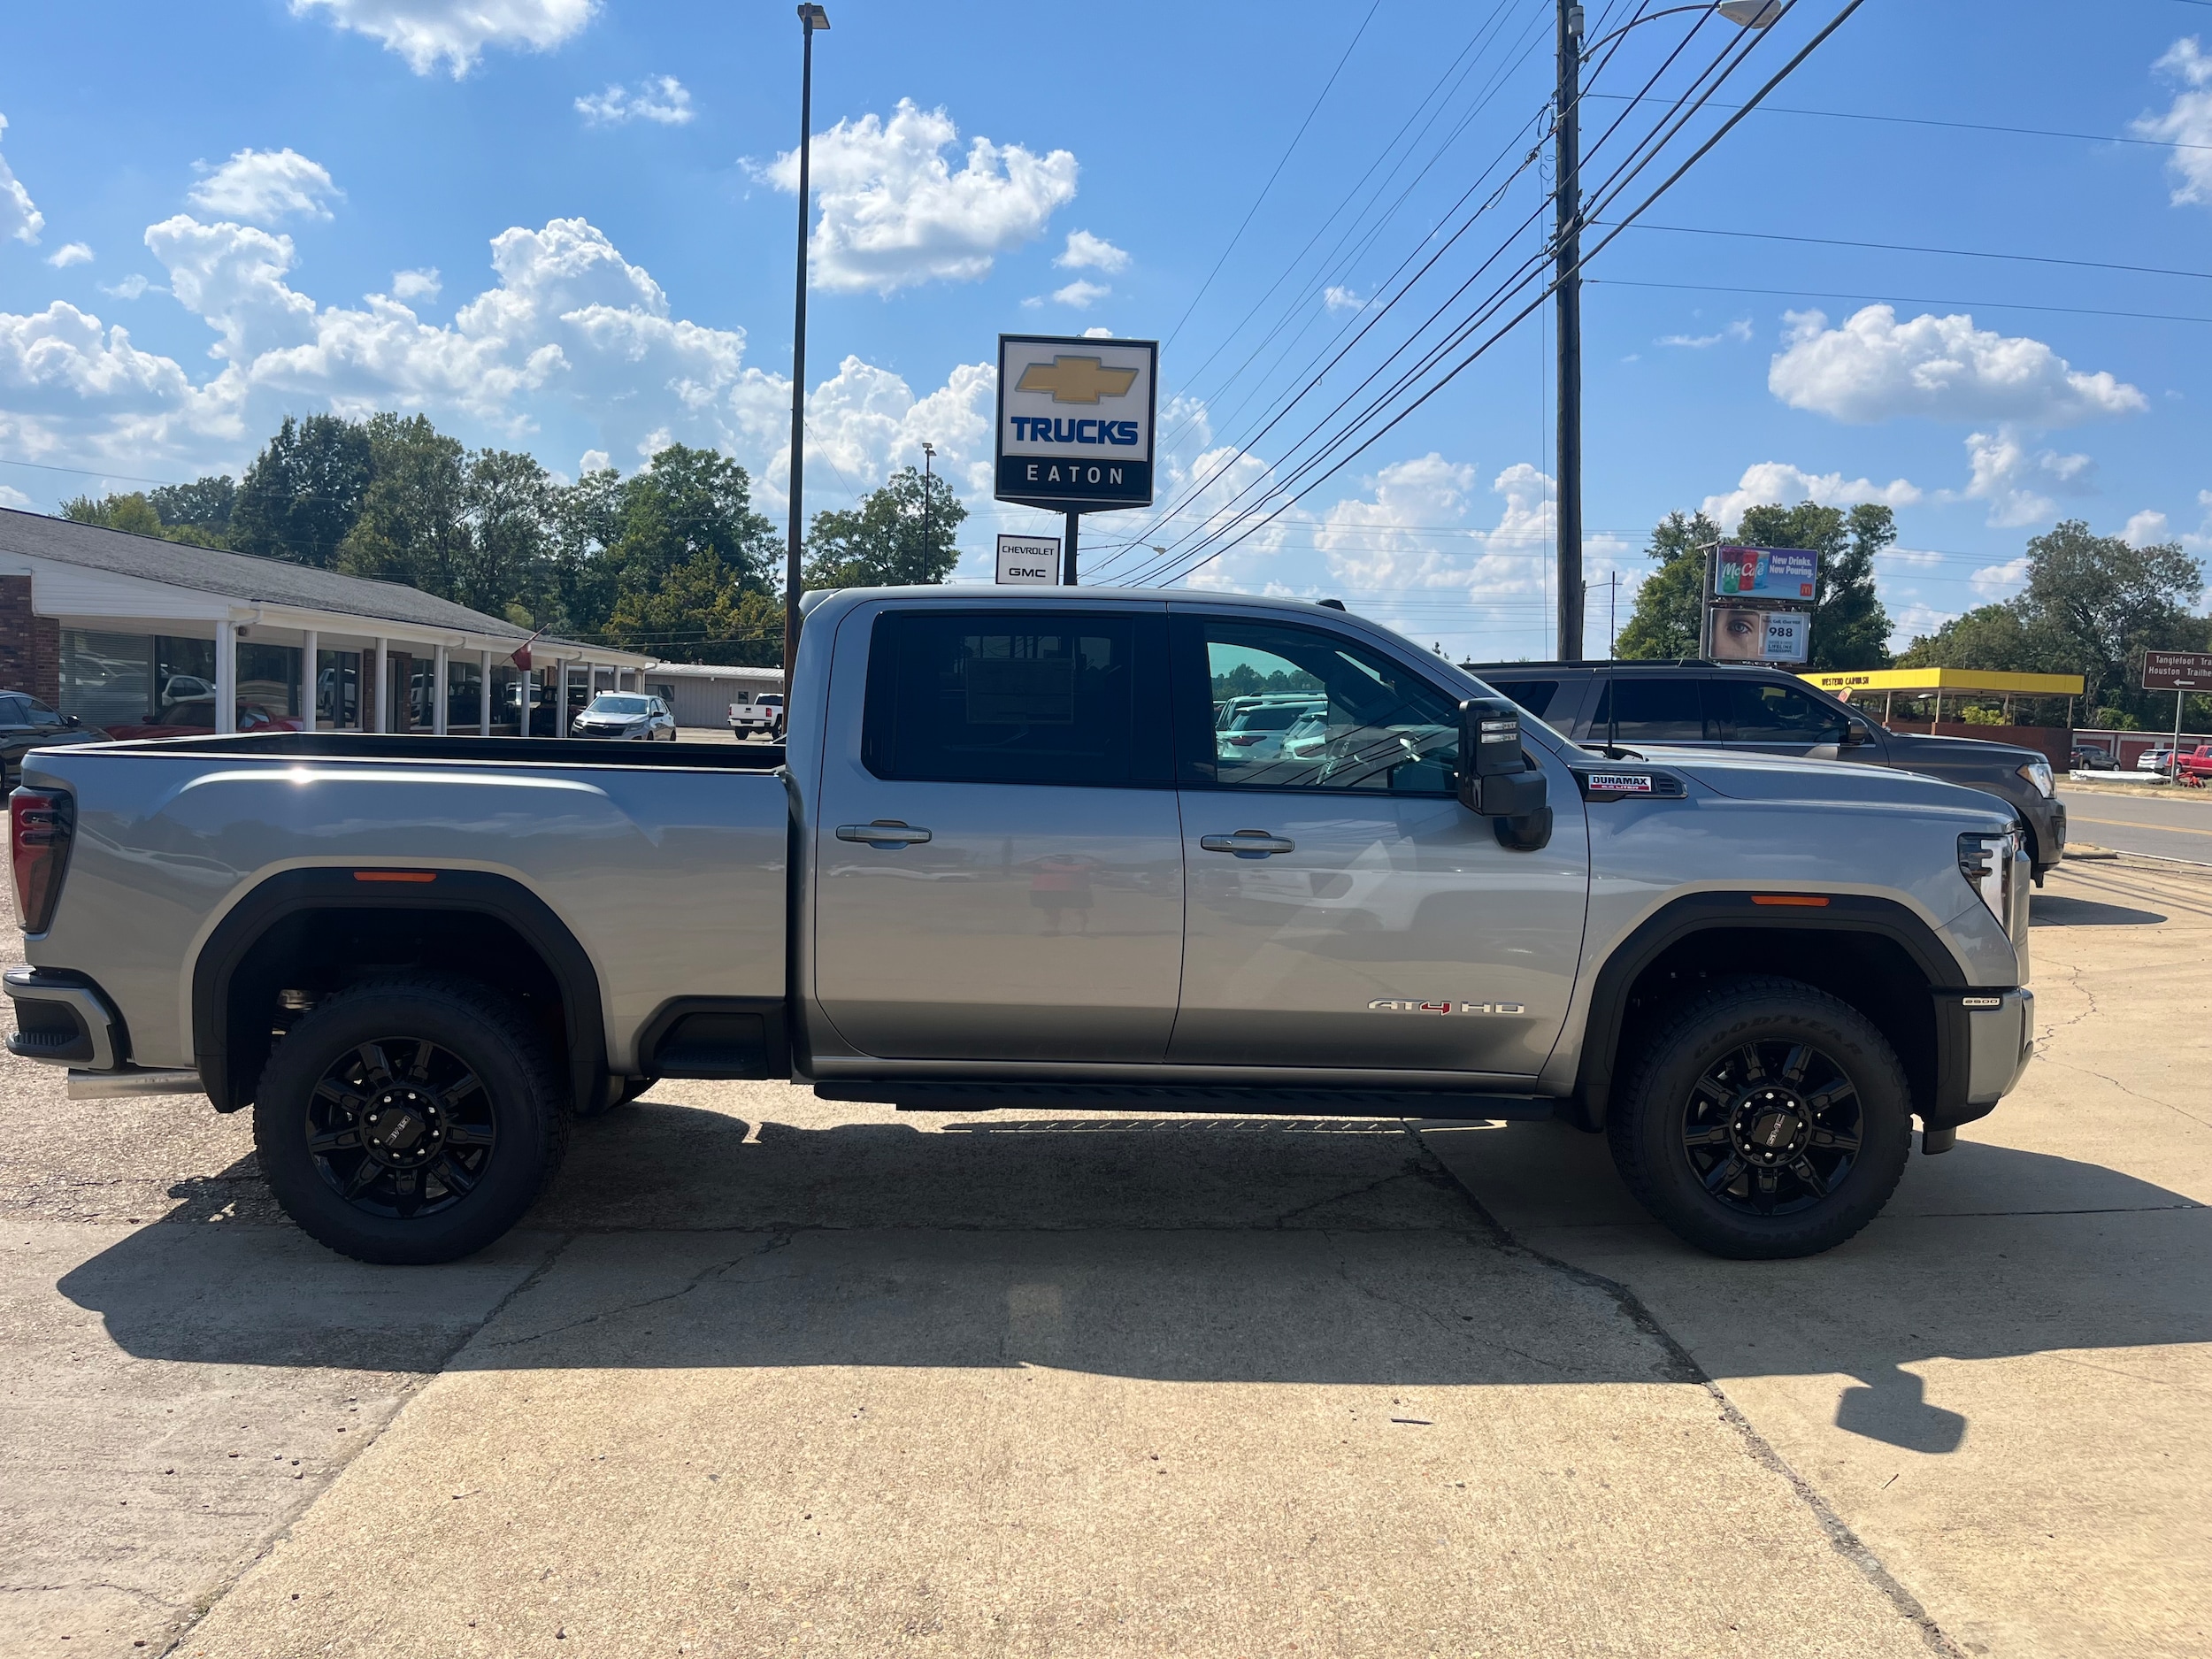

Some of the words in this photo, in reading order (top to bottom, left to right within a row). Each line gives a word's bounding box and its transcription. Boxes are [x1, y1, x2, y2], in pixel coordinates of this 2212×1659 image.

[1010, 416, 1139, 446] TRUCKS
[1026, 465, 1124, 485] EATON
[1002, 545, 1056, 557] CHEVROLET
[1772, 555, 1787, 565] New
[1788, 557, 1812, 566] Drinks.
[1009, 567, 1047, 579] GMC
[1770, 565, 1786, 574] Now
[1786, 566, 1814, 579] Pouring.
[1769, 626, 1793, 637] 988
[2155, 655, 2194, 666] Tanglefoot
[2148, 666, 2180, 676] Houston
[1593, 776, 1647, 786] DURAMAX
[1368, 997, 1452, 1016] AT4
[1461, 1001, 1525, 1014] HD
[1765, 1112, 1786, 1147] GMC
